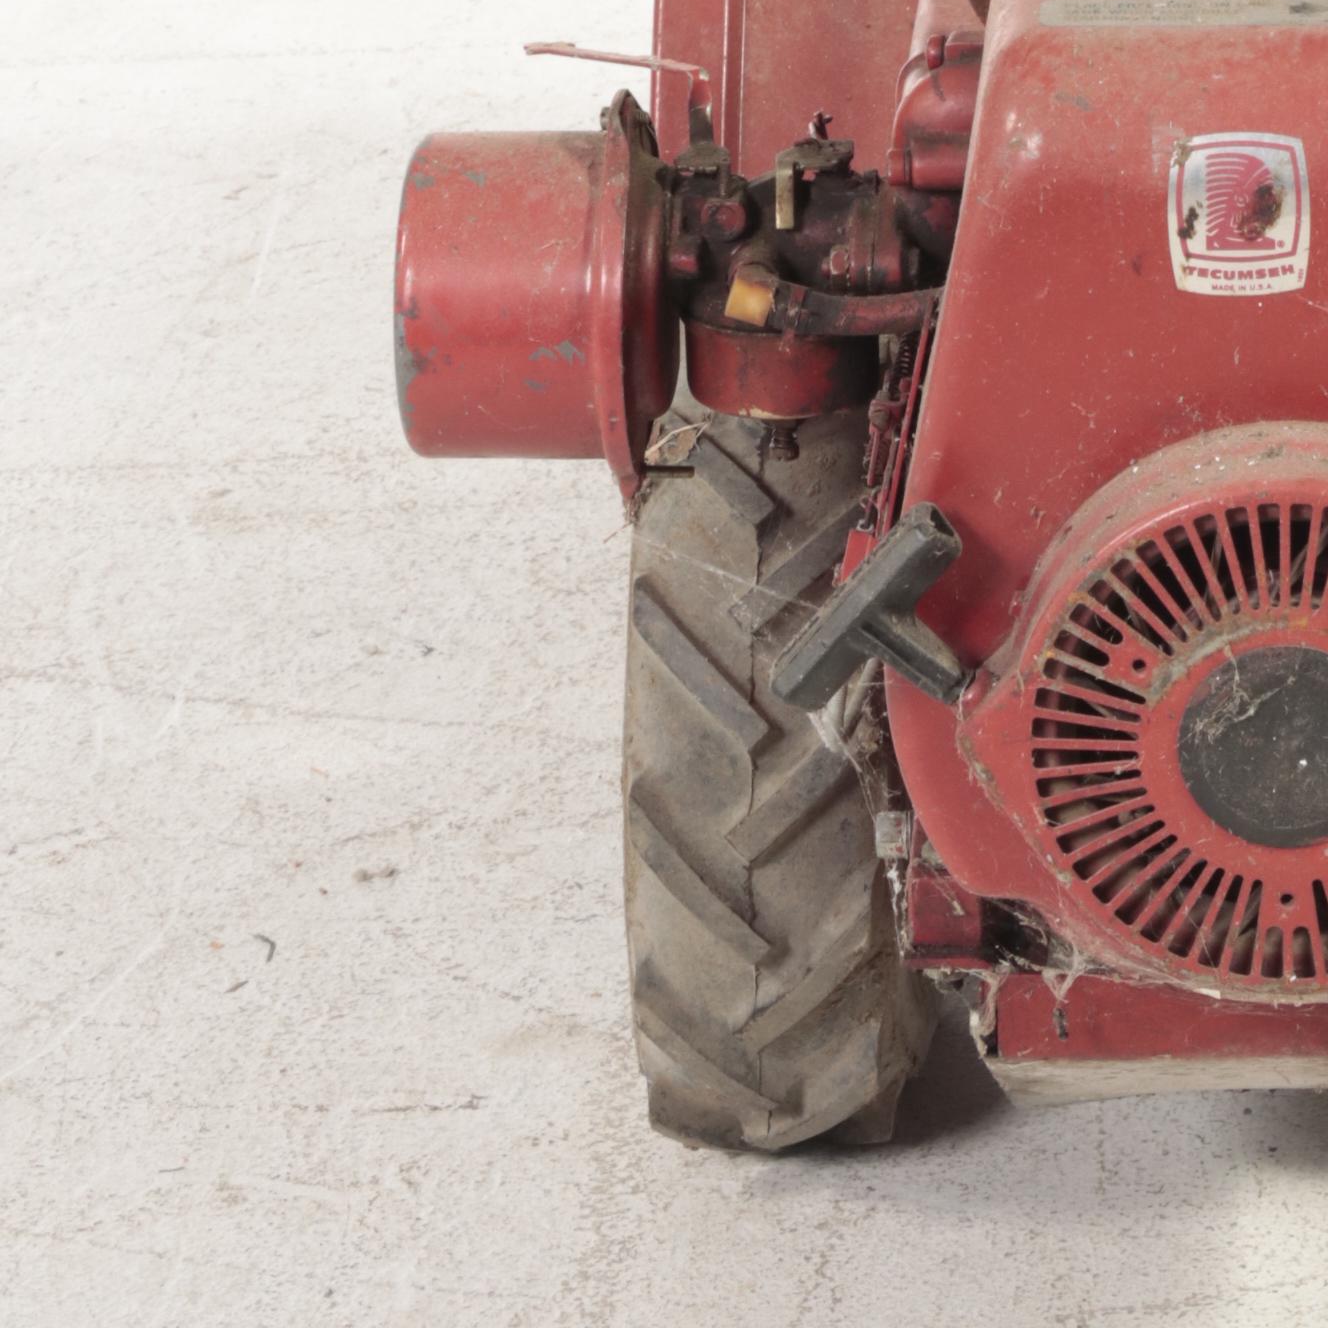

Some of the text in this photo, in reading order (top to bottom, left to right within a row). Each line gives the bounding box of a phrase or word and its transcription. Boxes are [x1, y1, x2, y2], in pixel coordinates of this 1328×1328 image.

[1183, 264, 1294, 281] TECUMSEH
[1212, 283, 1234, 292] MADE
[1238, 283, 1247, 291] IN
